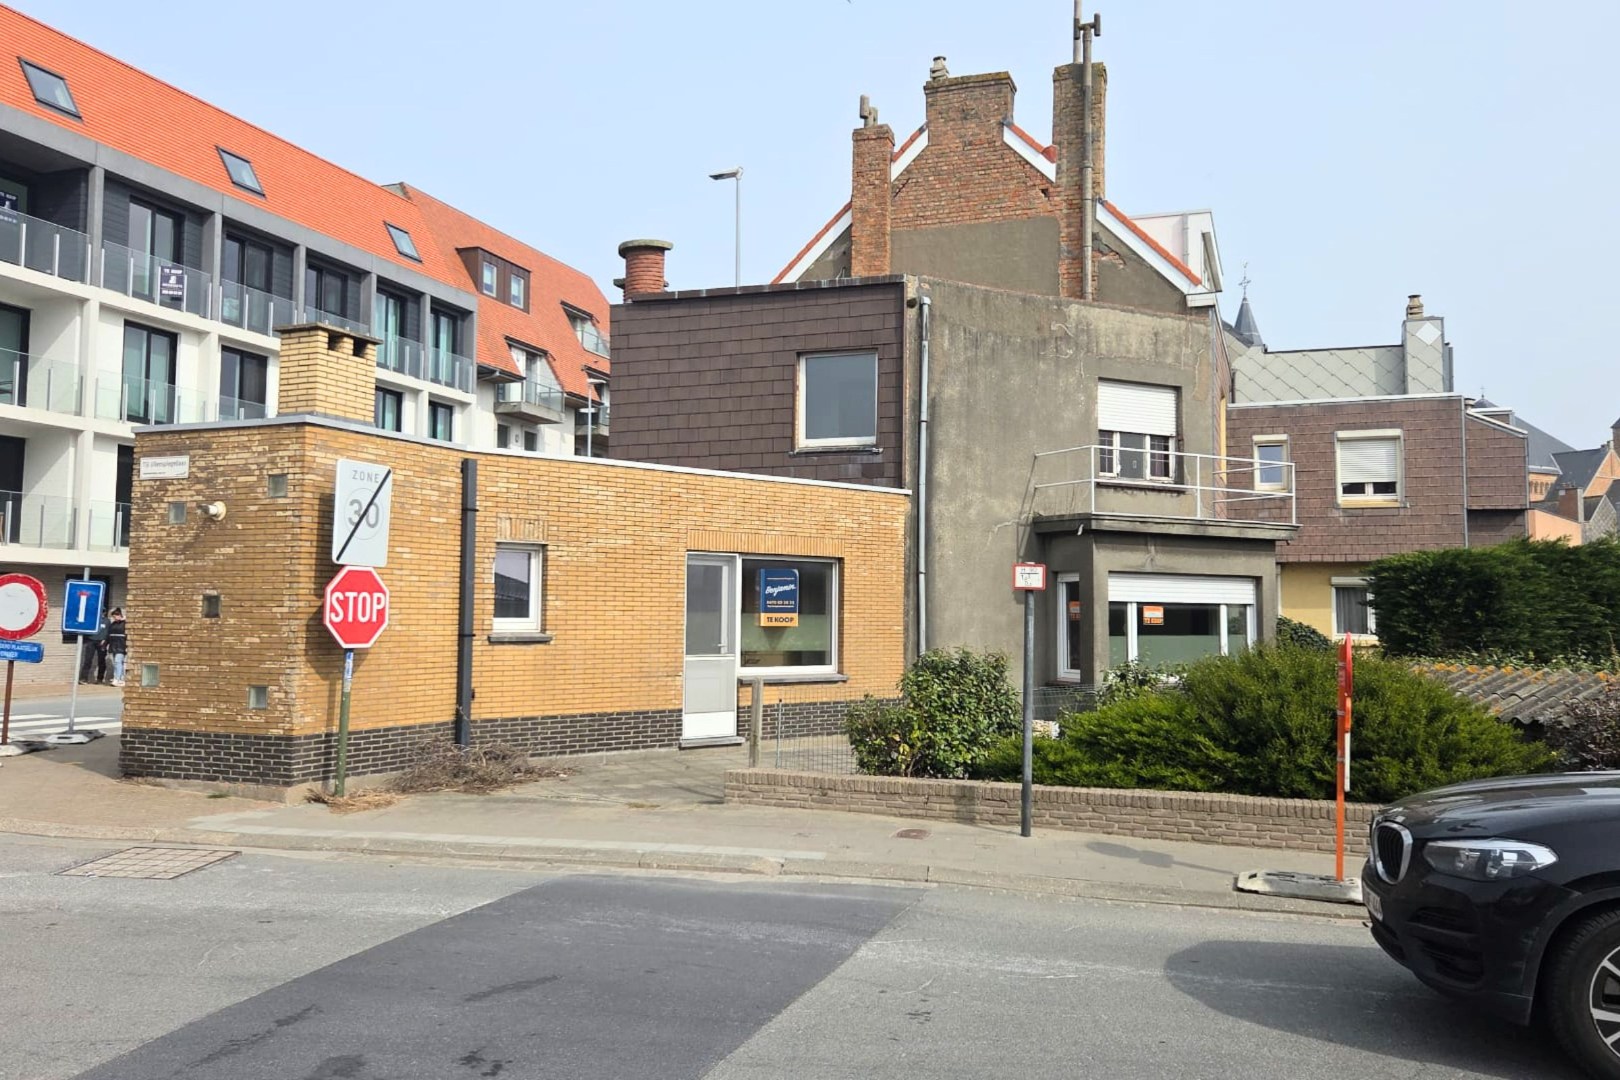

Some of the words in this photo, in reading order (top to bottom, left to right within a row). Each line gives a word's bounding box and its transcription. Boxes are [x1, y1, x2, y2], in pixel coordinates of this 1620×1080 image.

[352, 470, 380, 484] ZONE
[348, 499, 380, 529] 30
[330, 591, 385, 623] STOP
